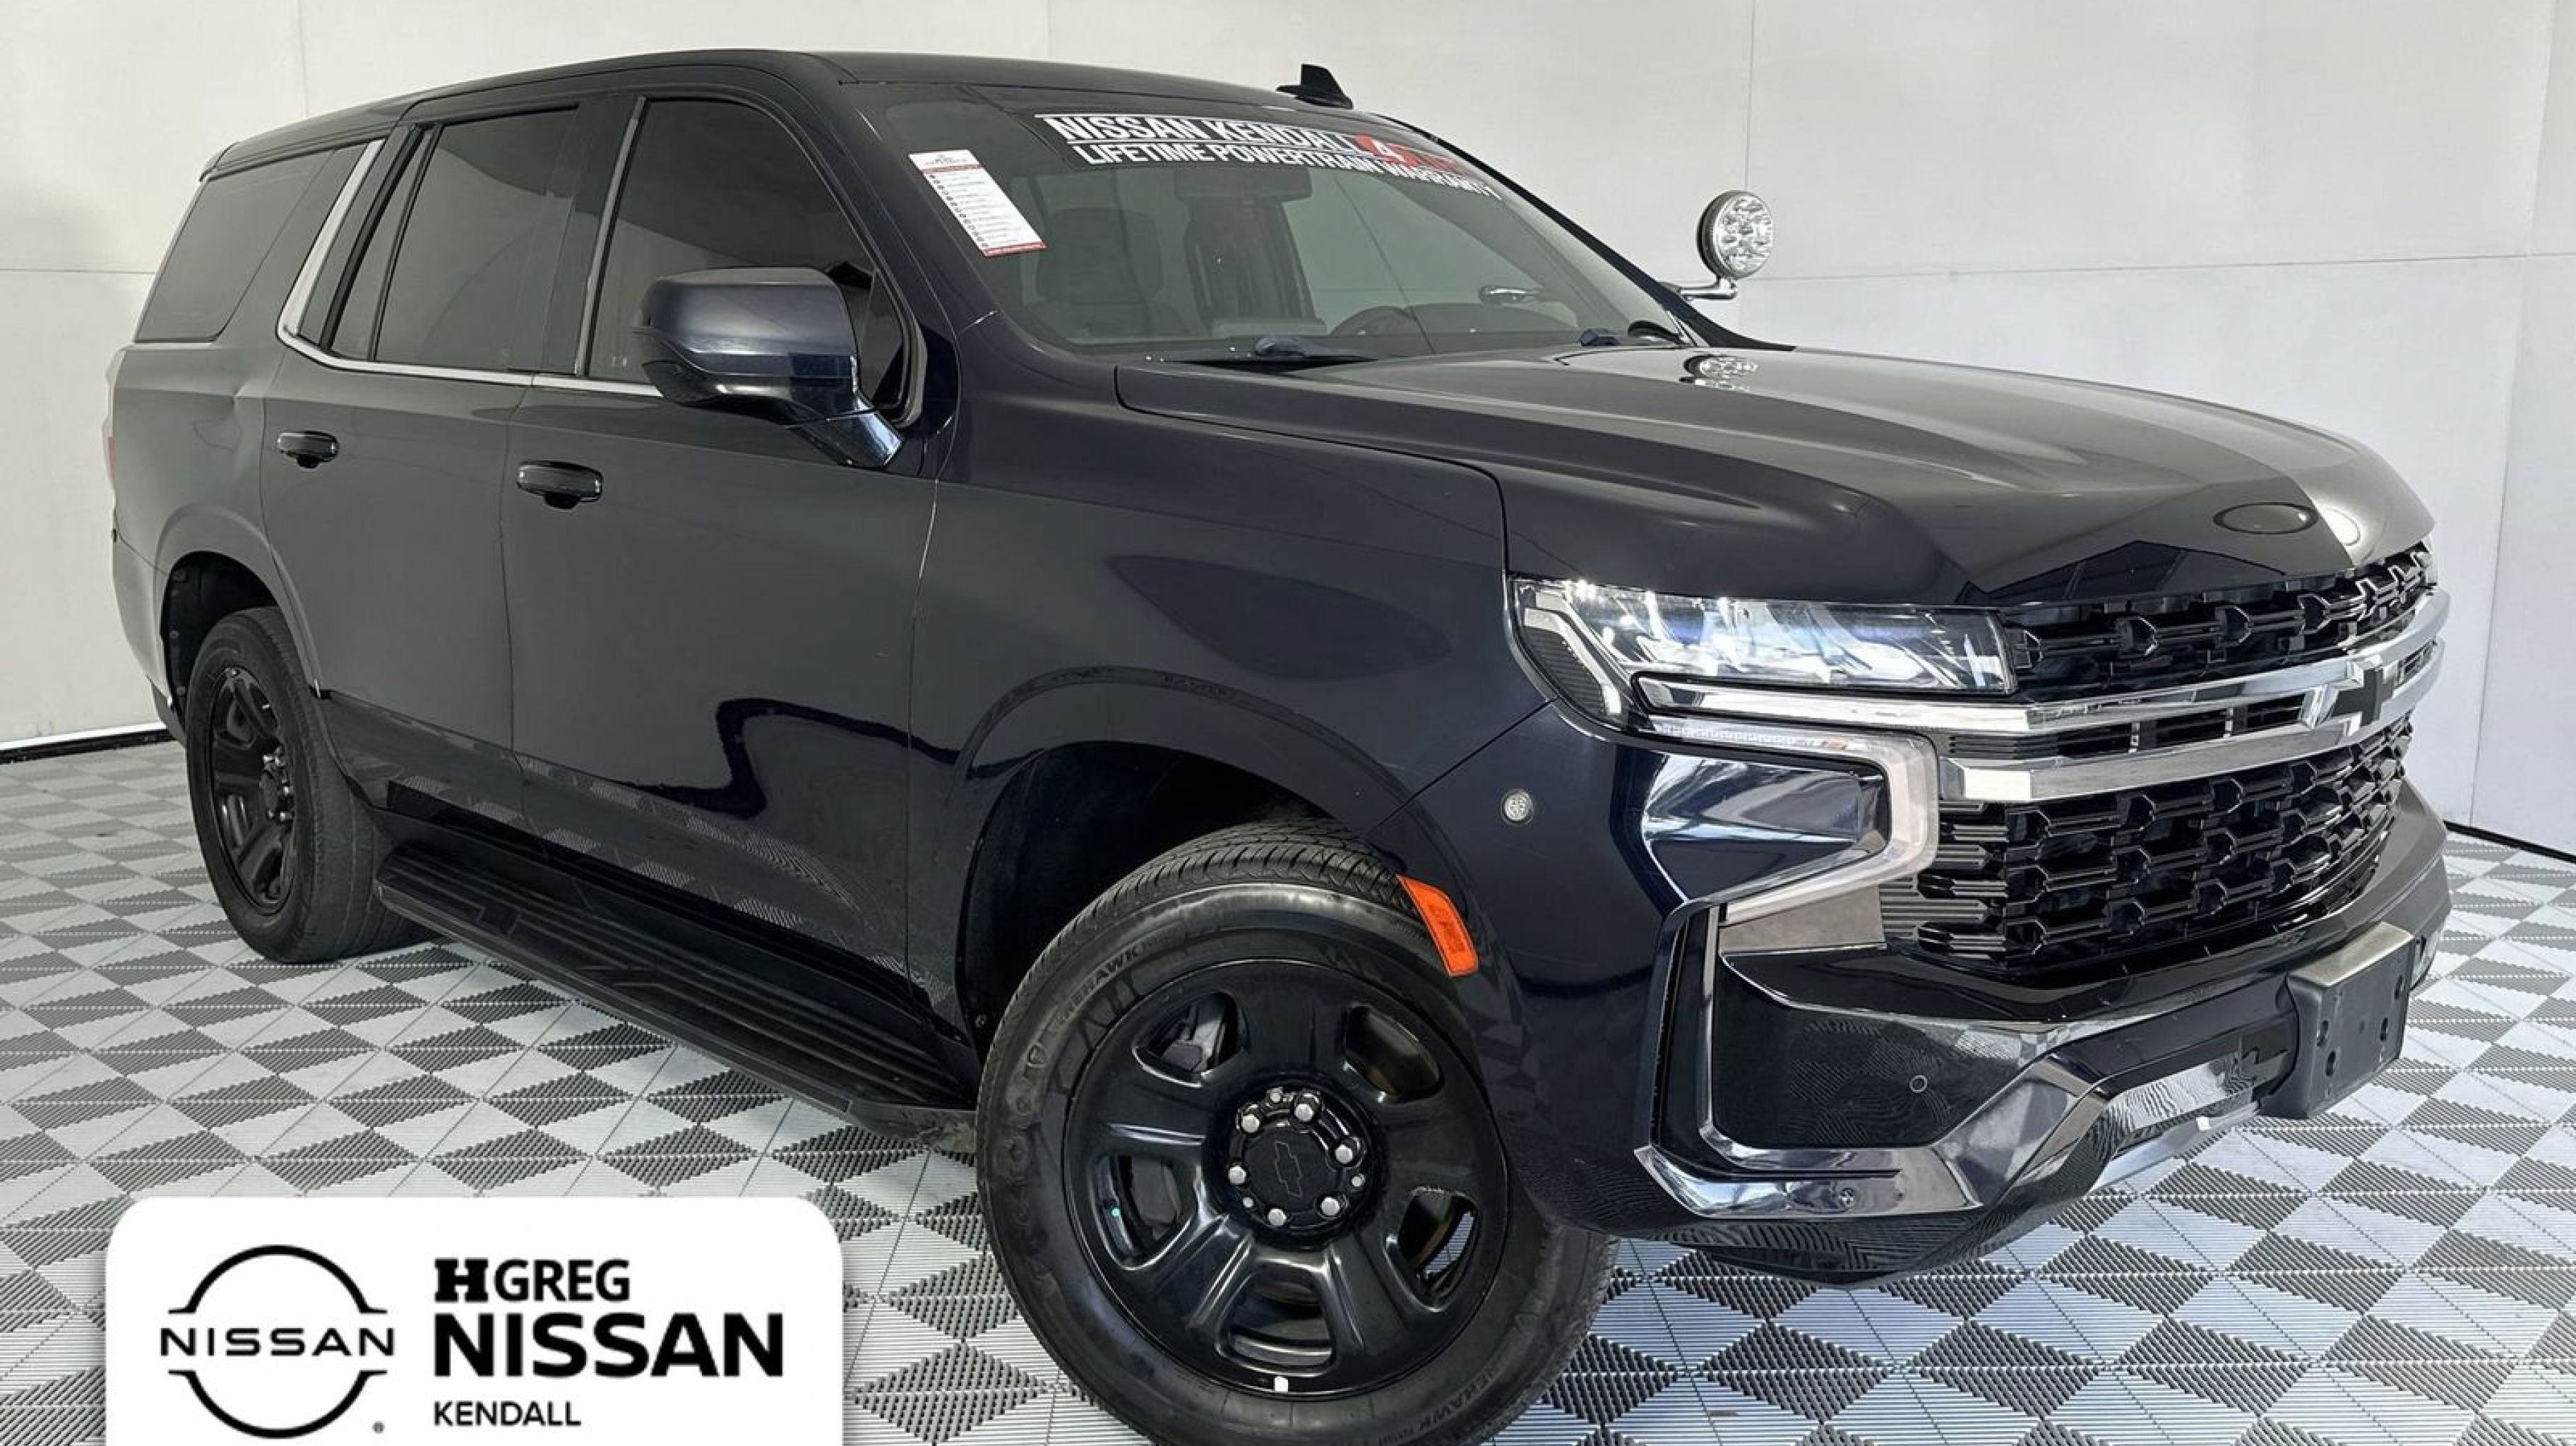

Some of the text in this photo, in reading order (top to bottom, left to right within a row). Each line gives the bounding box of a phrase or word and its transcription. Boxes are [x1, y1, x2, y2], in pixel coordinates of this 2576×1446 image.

[1043, 116, 1212, 140] NISSAN
[1200, 119, 1374, 155] KENDALL
[1071, 143, 1215, 165] LIFETIME
[1205, 143, 1384, 174] POWERTRAIN
